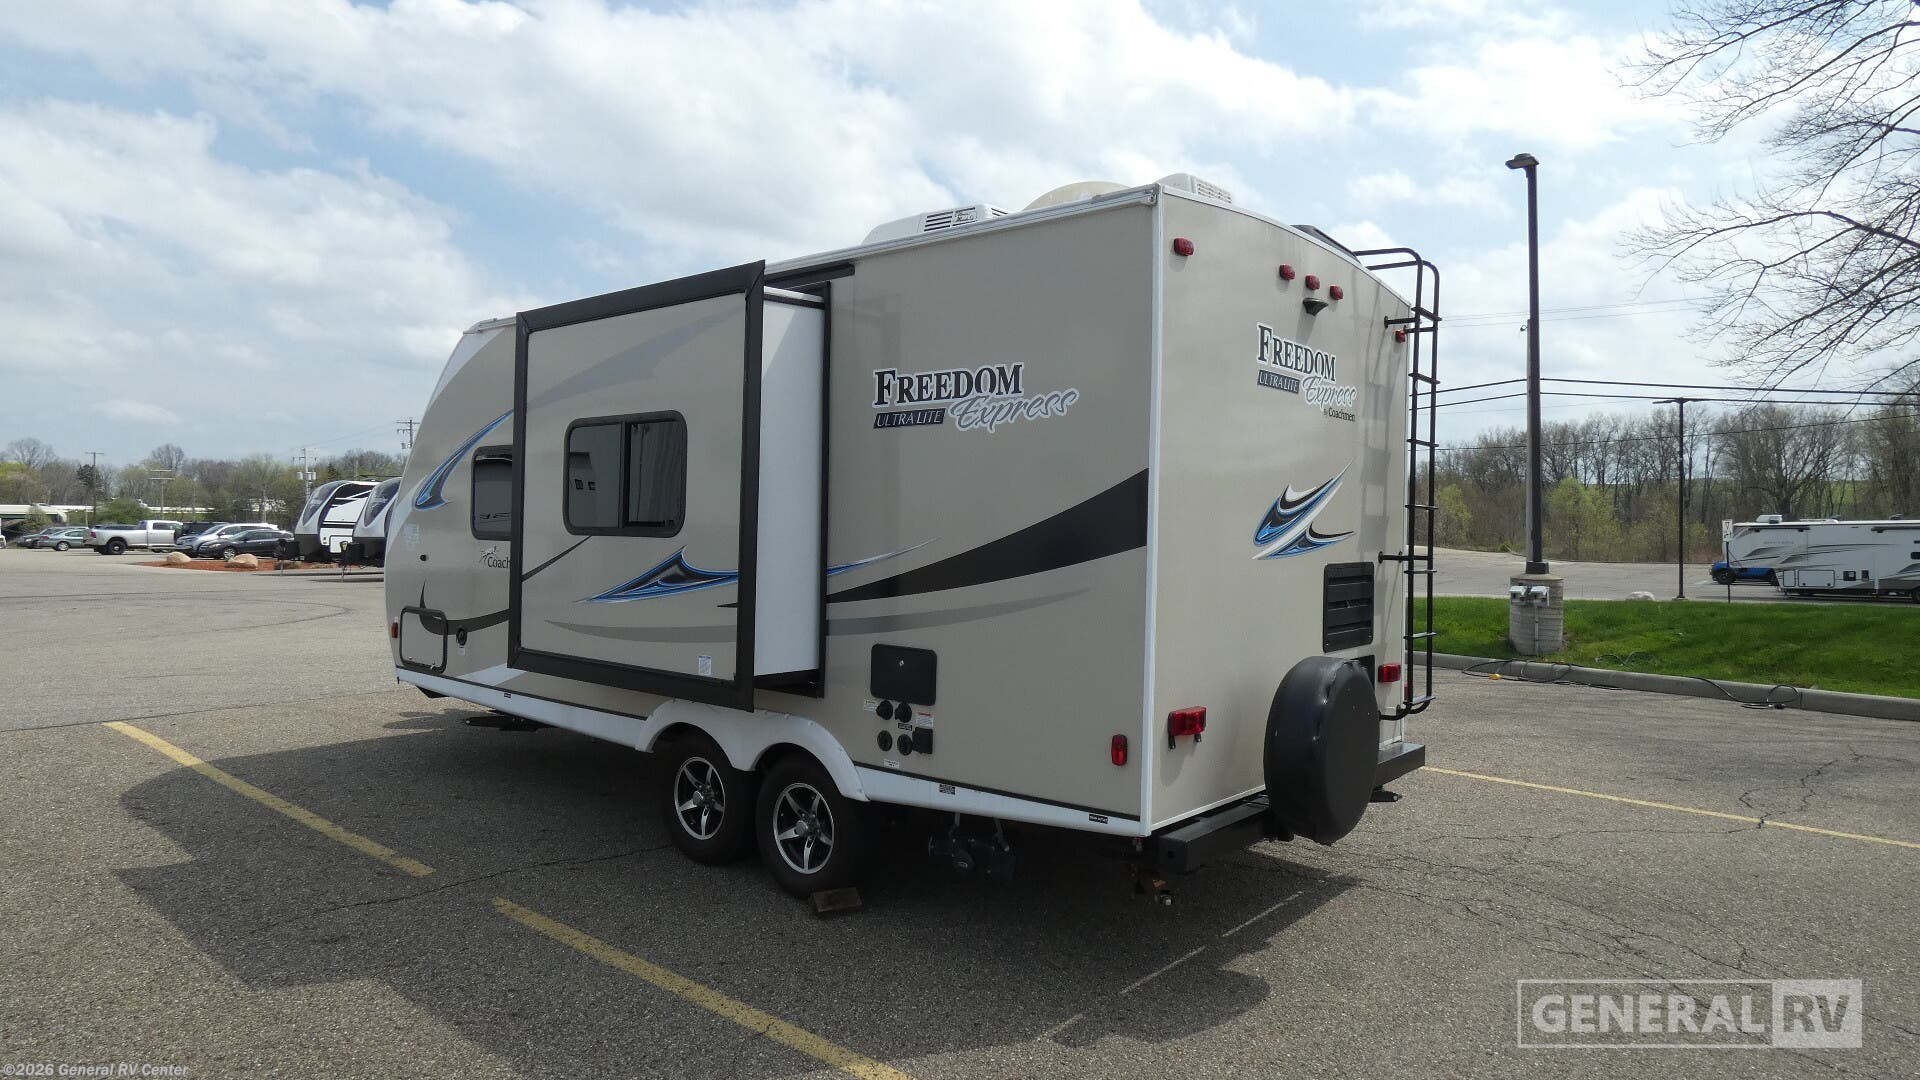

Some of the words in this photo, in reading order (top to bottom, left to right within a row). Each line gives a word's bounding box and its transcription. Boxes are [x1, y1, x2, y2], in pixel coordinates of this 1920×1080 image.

[1257, 324, 1336, 382] FREEDOM
[873, 363, 1023, 406] FREEDOM
[1260, 371, 1284, 389] ULTRA
[1284, 377, 1299, 392] LITE
[1302, 375, 1356, 409] Express
[876, 412, 915, 427] ULTRA
[916, 410, 942, 424] LITE
[950, 390, 1078, 430] Express
[1328, 407, 1356, 422] Coachmen
